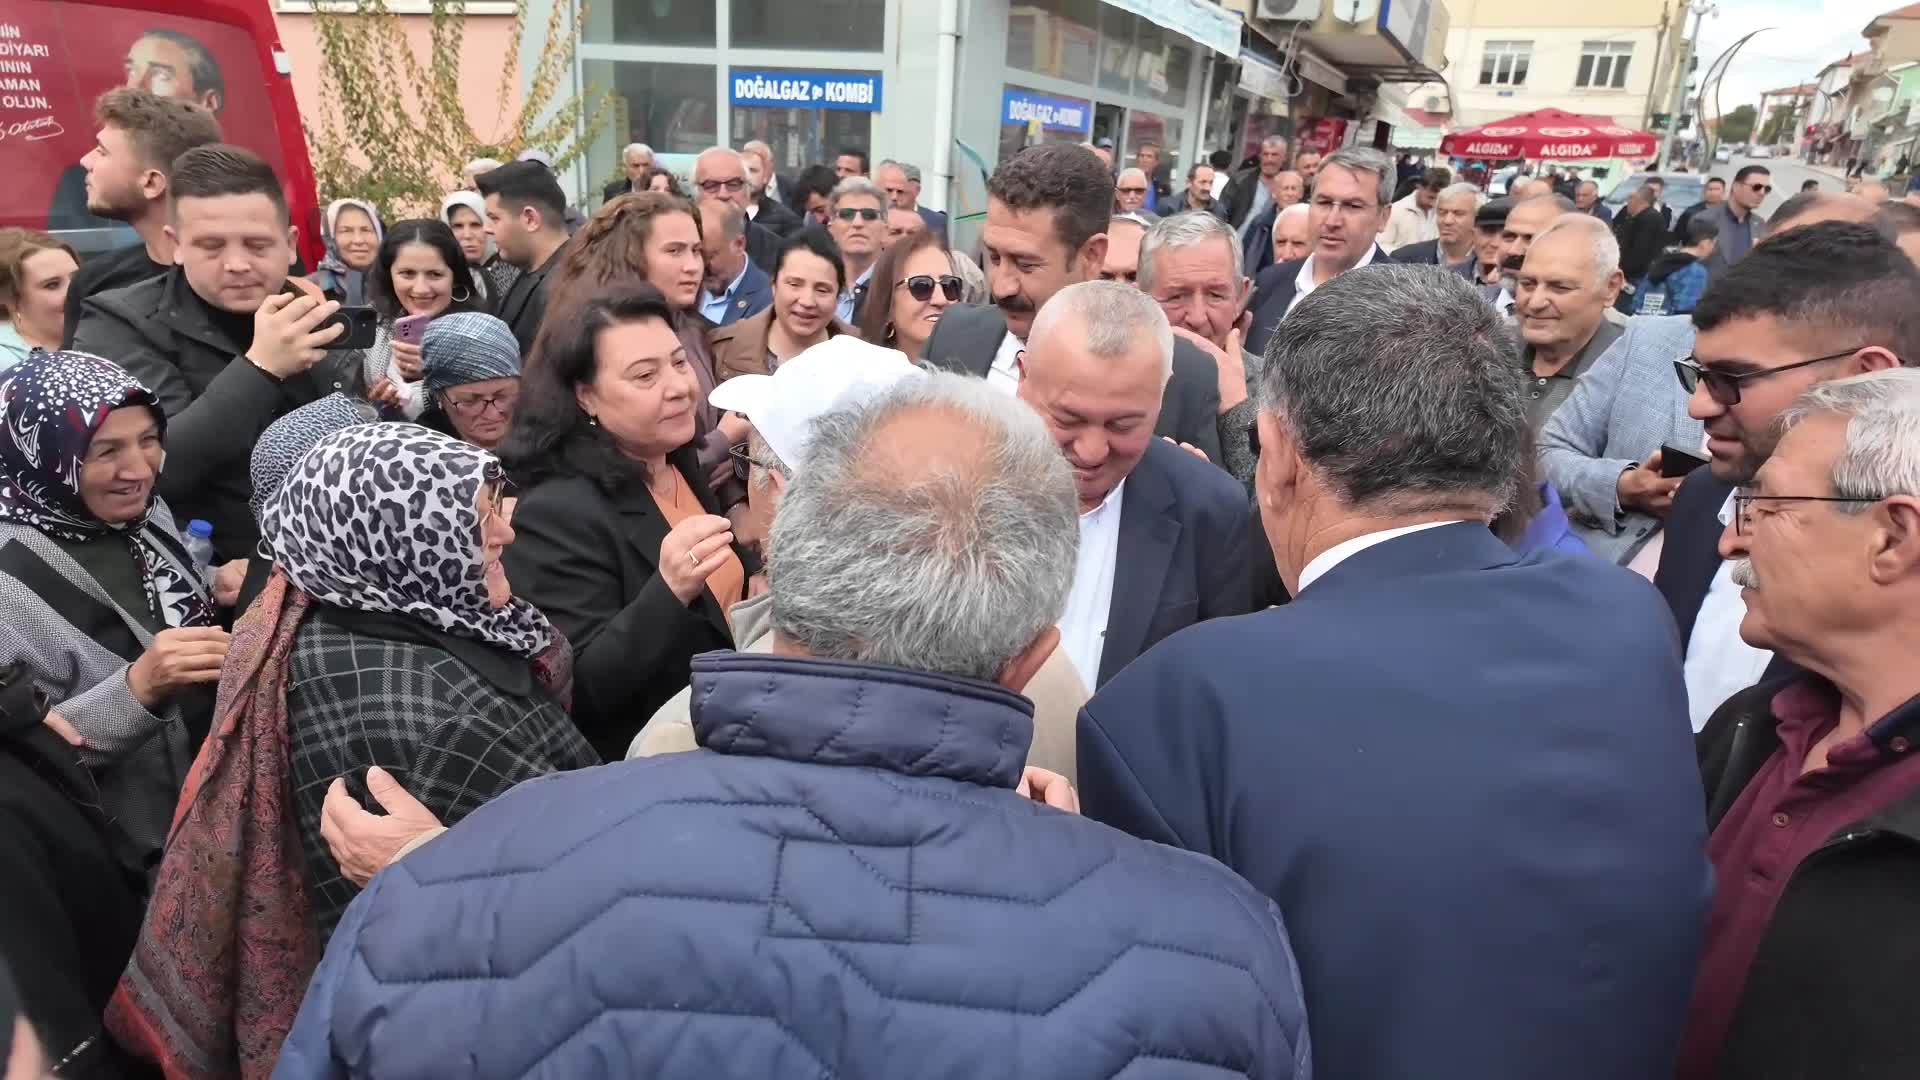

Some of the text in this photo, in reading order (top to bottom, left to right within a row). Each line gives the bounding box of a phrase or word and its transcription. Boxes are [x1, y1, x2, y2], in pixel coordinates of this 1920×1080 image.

[735, 75, 809, 101] DOĞALGAZ
[825, 79, 873, 104] KOMBİ
[2, 96, 52, 109] OLUN.
[1465, 142, 1509, 155] ALGIDA
[1540, 143, 1592, 156] ALGIDA
